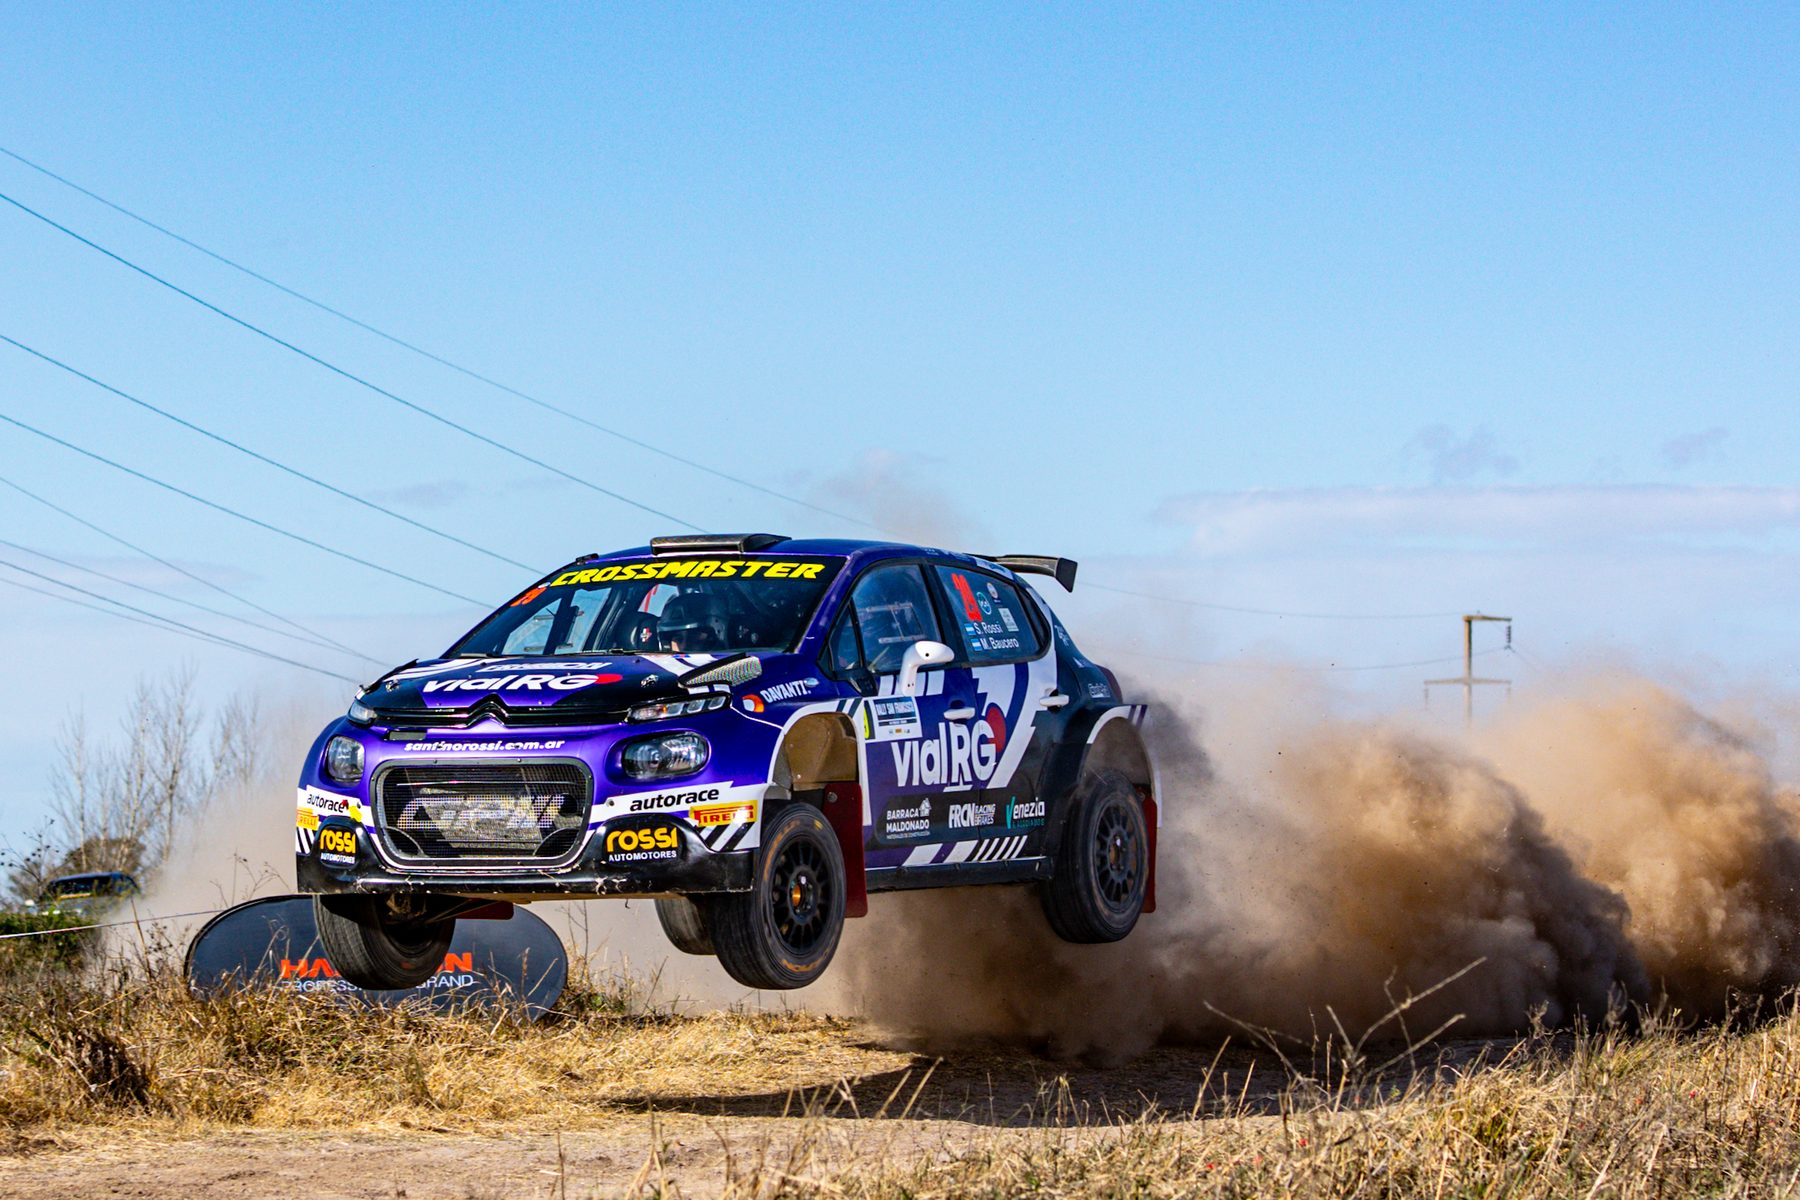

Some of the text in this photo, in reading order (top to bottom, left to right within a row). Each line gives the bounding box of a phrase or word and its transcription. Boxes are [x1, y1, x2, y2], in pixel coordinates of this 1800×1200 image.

[550, 560, 826, 587] CROSSMASTER
[981, 621, 1003, 634] Rossi
[404, 740, 566, 752] santinorossi.com.ar
[307, 794, 345, 813] autorace
[630, 789, 720, 811] autorace
[886, 808, 919, 820] BARRACA
[1006, 795, 1046, 829] Venezia
[886, 819, 930, 833] MALDONADO
[608, 850, 677, 862] AUTOMOTORES
